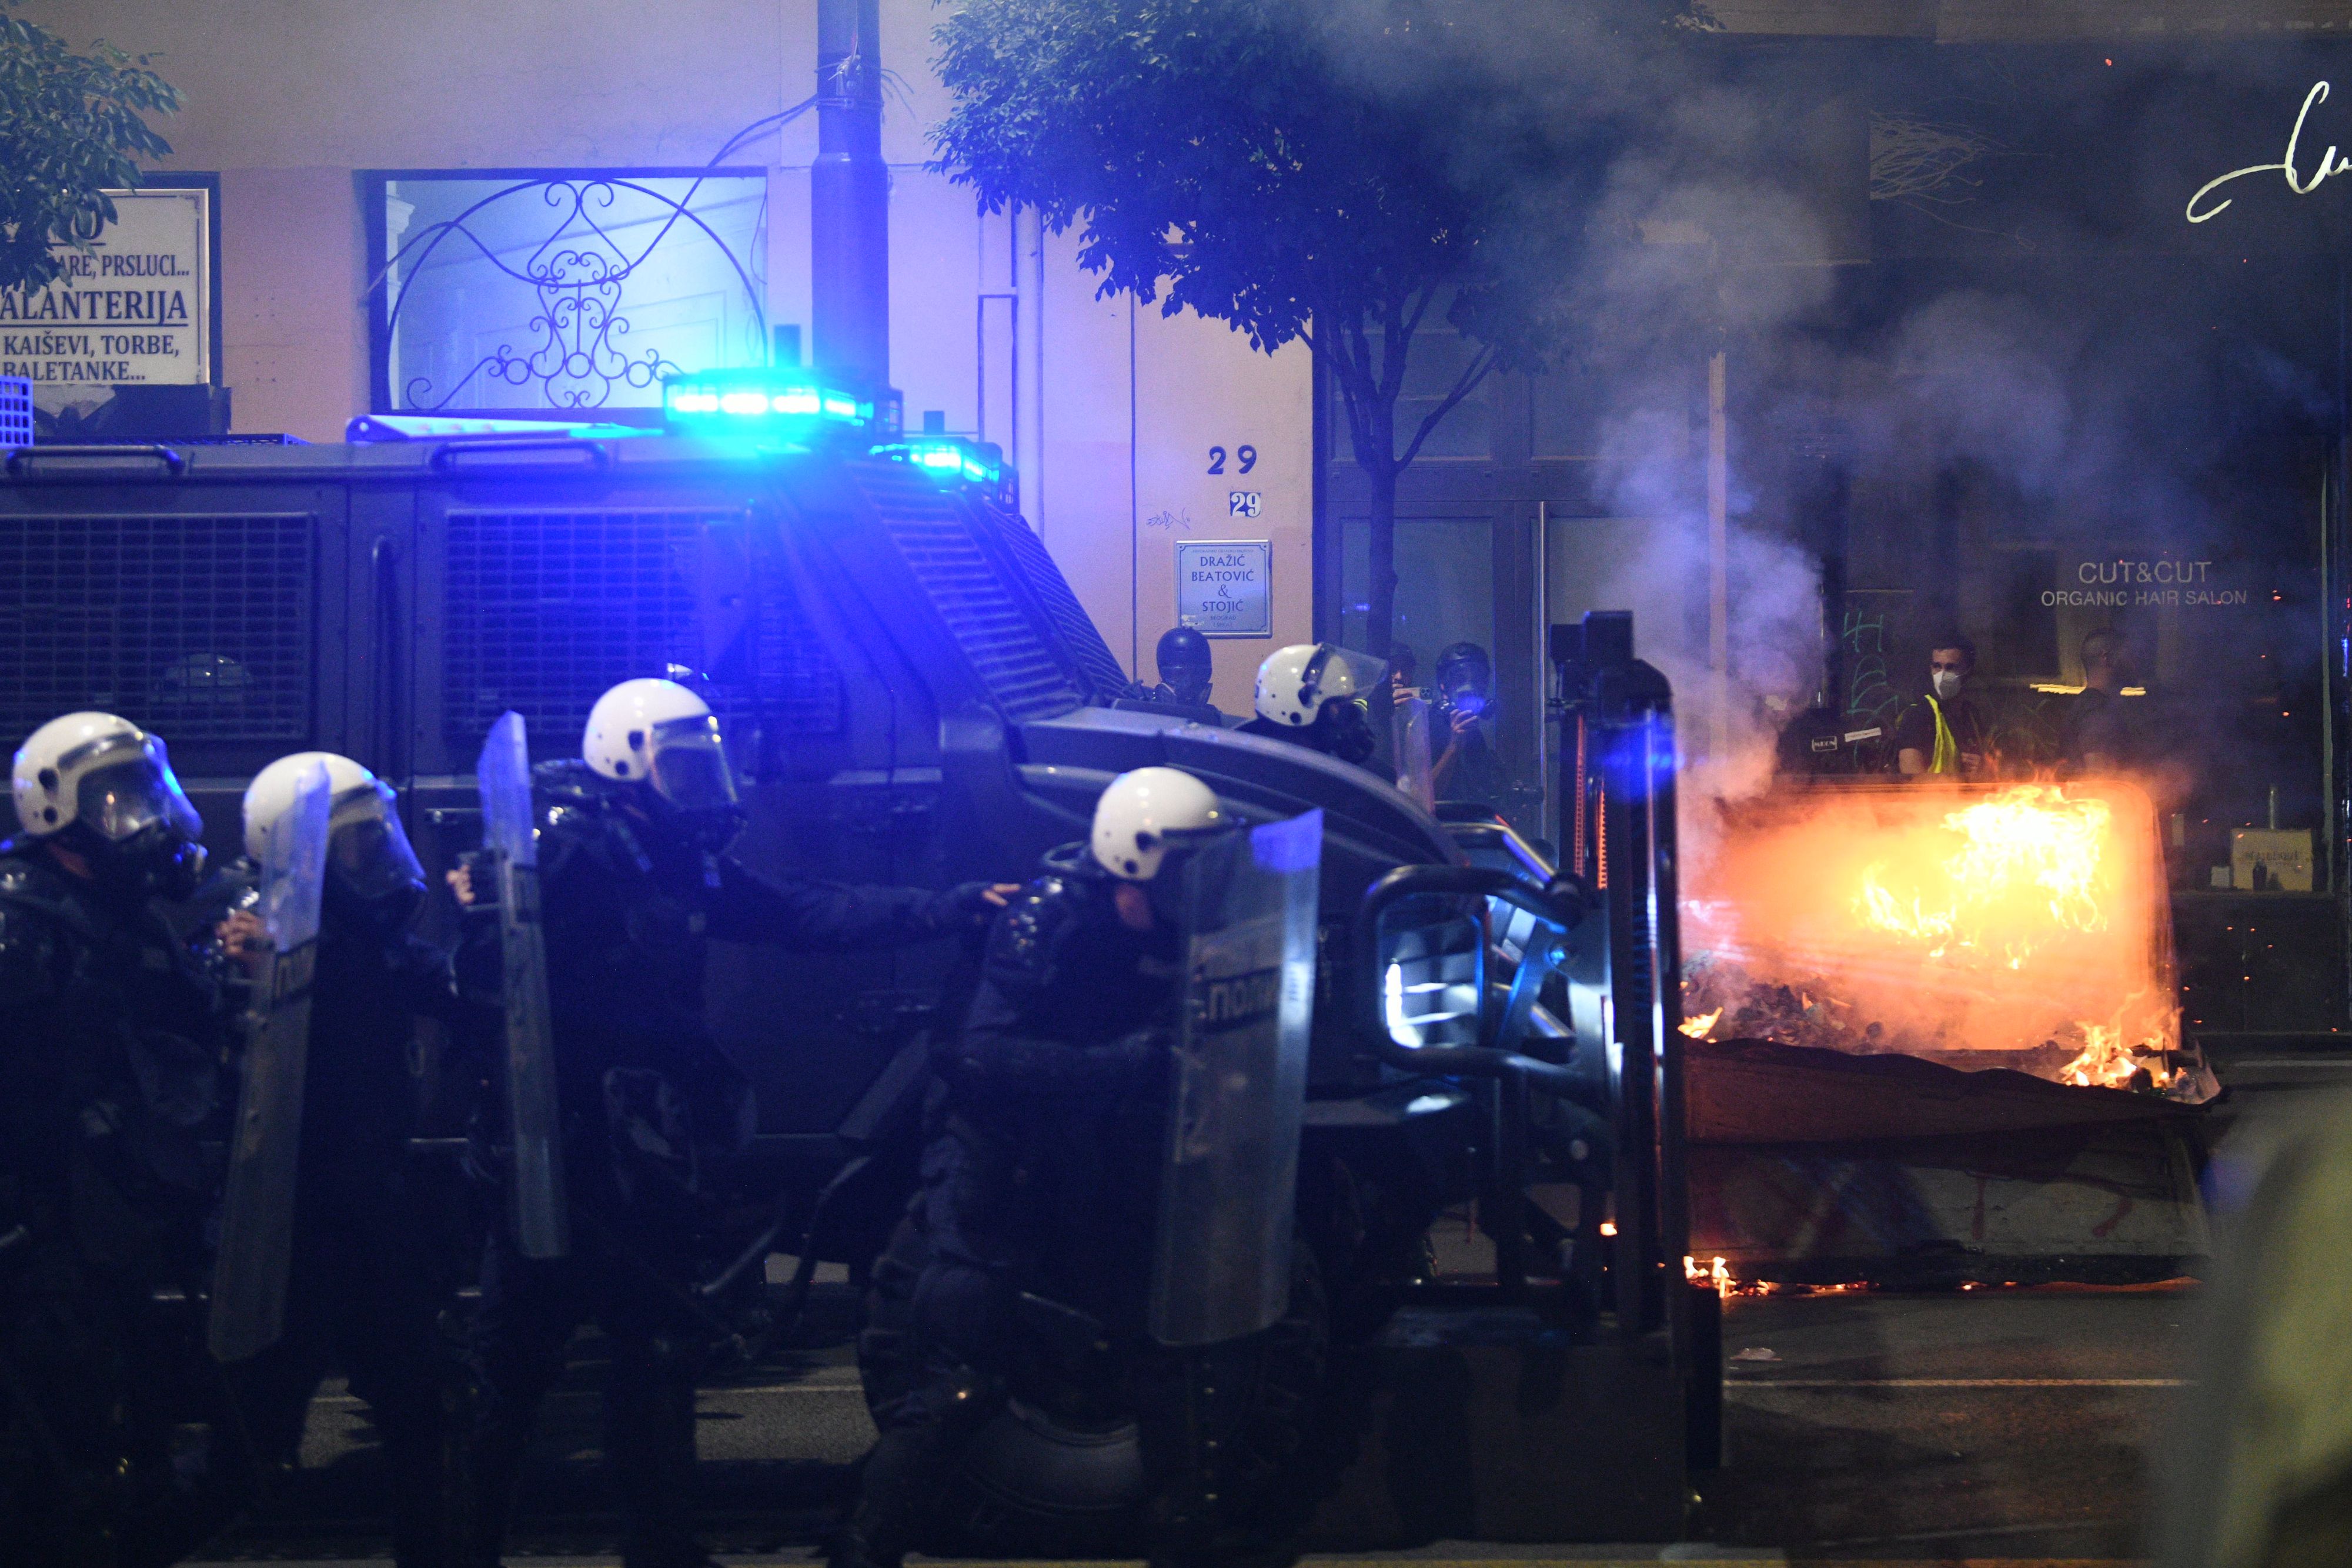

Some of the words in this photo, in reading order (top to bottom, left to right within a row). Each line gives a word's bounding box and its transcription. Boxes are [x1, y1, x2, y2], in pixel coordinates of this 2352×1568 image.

[102, 254, 189, 276] PRSLUCI...
[4, 330, 95, 357] KAIŠEVI,
[101, 335, 179, 357] TORBE,
[1230, 492, 1262, 518] 29
[1200, 554, 1245, 567] DRAŽIĆ
[1191, 569, 1254, 581] BEATOVIĆ
[2079, 560, 2212, 584] CUT&CUT
[1218, 584, 1233, 599] &
[2041, 590, 2127, 606] ORGANIC
[2135, 590, 2179, 606] HAIR
[2185, 590, 2247, 605] SALON
[1202, 599, 1244, 613] STOJIĆ
